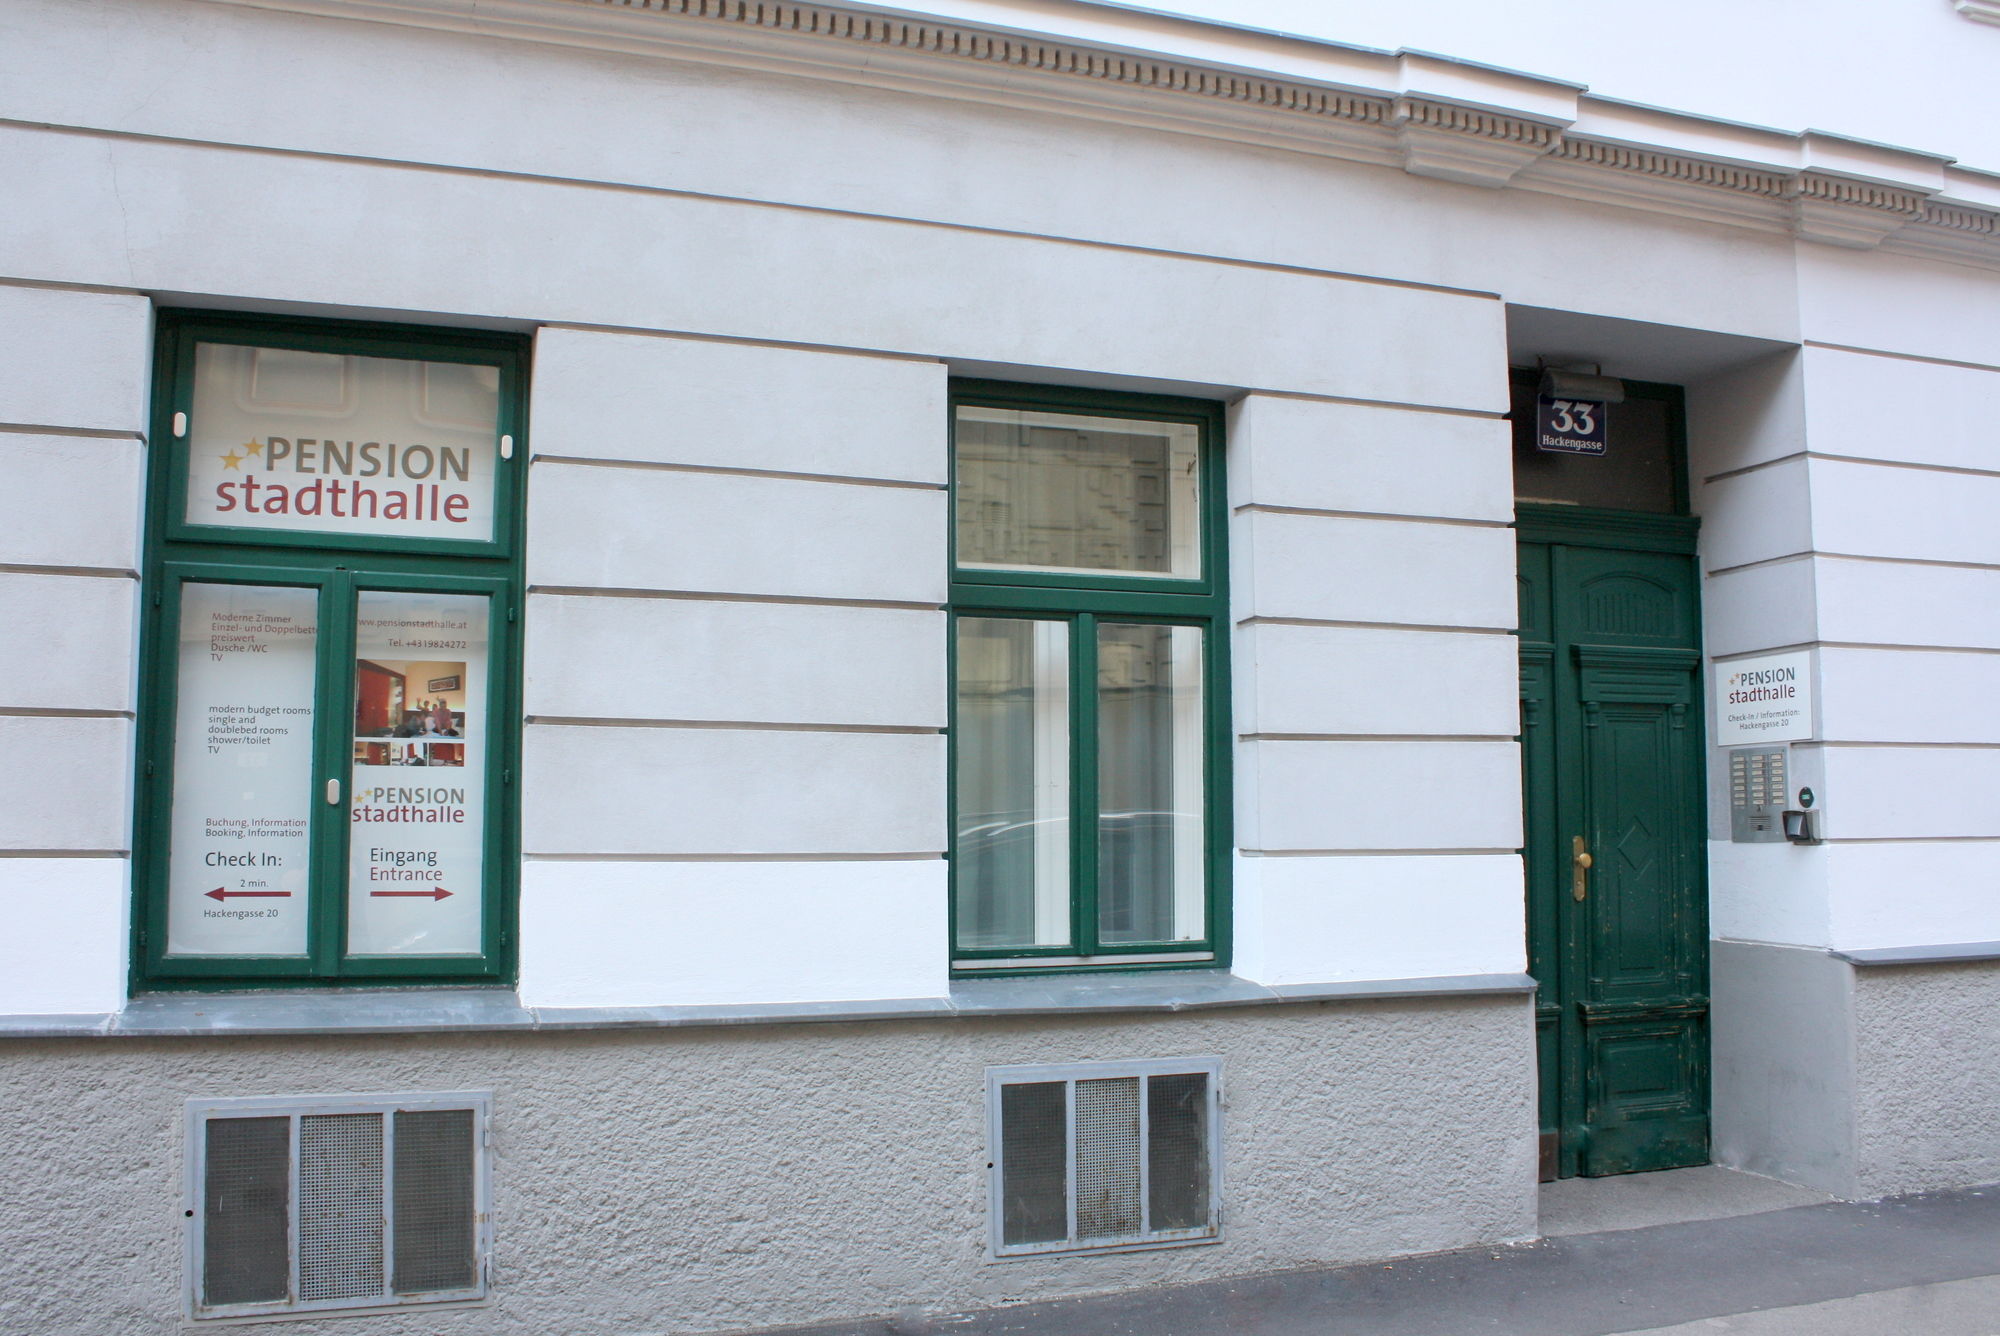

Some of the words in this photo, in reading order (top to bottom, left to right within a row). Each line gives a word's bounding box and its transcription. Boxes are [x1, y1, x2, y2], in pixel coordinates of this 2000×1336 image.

[1551, 400, 1595, 435] 33
[1542, 434, 1602, 450] Hackengasse
[265, 436, 470, 482] PENSION
[215, 474, 470, 523] stadthalle
[211, 612, 254, 622] Moderne
[256, 614, 292, 623] Zimmer
[211, 622, 242, 632] Einzel-
[244, 624, 263, 633] und
[211, 634, 255, 643] preiswert
[387, 638, 404, 647] Tel.
[211, 642, 245, 652] Dusche
[210, 653, 223, 662] TV
[1741, 667, 1795, 686] PENSION
[1729, 684, 1795, 704] stadthalle
[208, 704, 245, 713] modern
[247, 705, 280, 716] budget
[282, 707, 312, 715] rooms
[208, 715, 236, 726] single
[238, 716, 256, 724] and
[1740, 721, 1779, 730] Hackengasse
[1781, 718, 1789, 727] 20
[208, 725, 258, 734] doublebed
[259, 727, 289, 735] rooms
[207, 735, 271, 745] shower/toilet
[207, 745, 220, 754] TV
[373, 787, 465, 804] PENSION
[352, 804, 465, 823] stadthalle
[205, 817, 250, 829] Buchung,
[251, 818, 307, 827] Information
[205, 828, 246, 839] Booking,
[248, 828, 303, 837] Information
[205, 851, 257, 867] Check
[261, 852, 282, 867] In:
[370, 848, 437, 867] Eingang
[370, 867, 443, 881] Entrance
[240, 879, 246, 888] 2
[248, 879, 269, 888] min.
[203, 909, 265, 920] Hackengasse
[267, 909, 279, 918] 20
